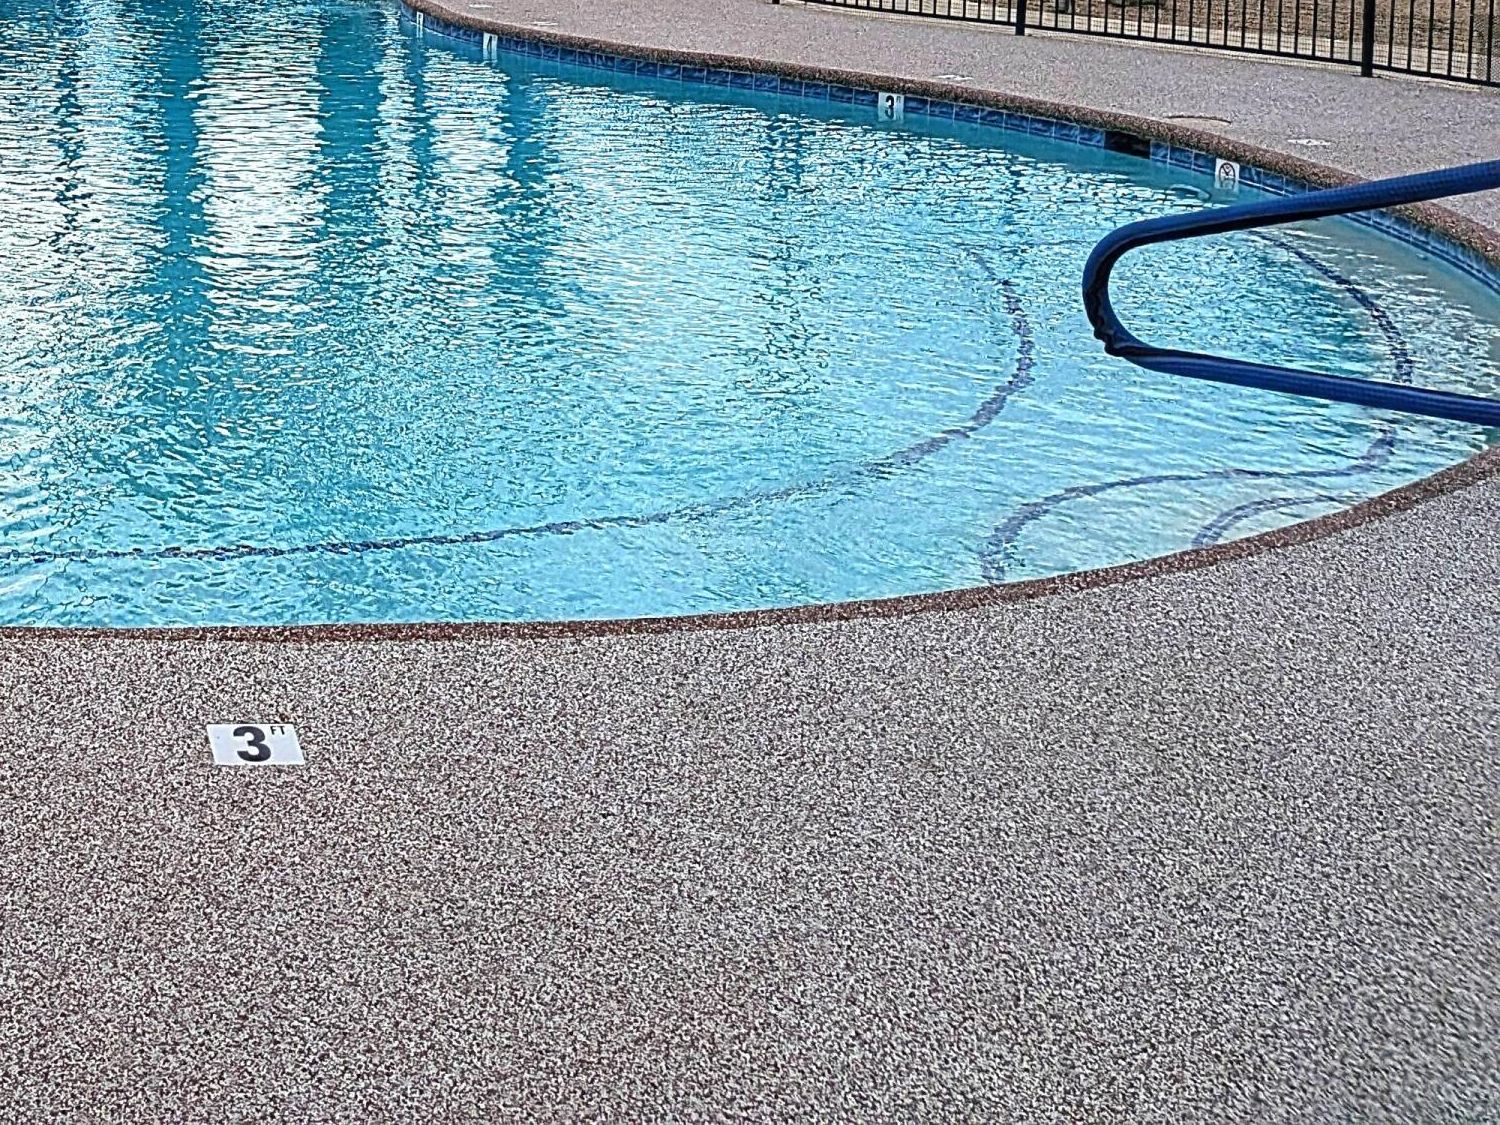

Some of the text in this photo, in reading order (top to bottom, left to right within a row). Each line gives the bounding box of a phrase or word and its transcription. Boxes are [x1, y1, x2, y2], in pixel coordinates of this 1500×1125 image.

[885, 95, 895, 119] 3
[233, 725, 285, 762] 3 FT
